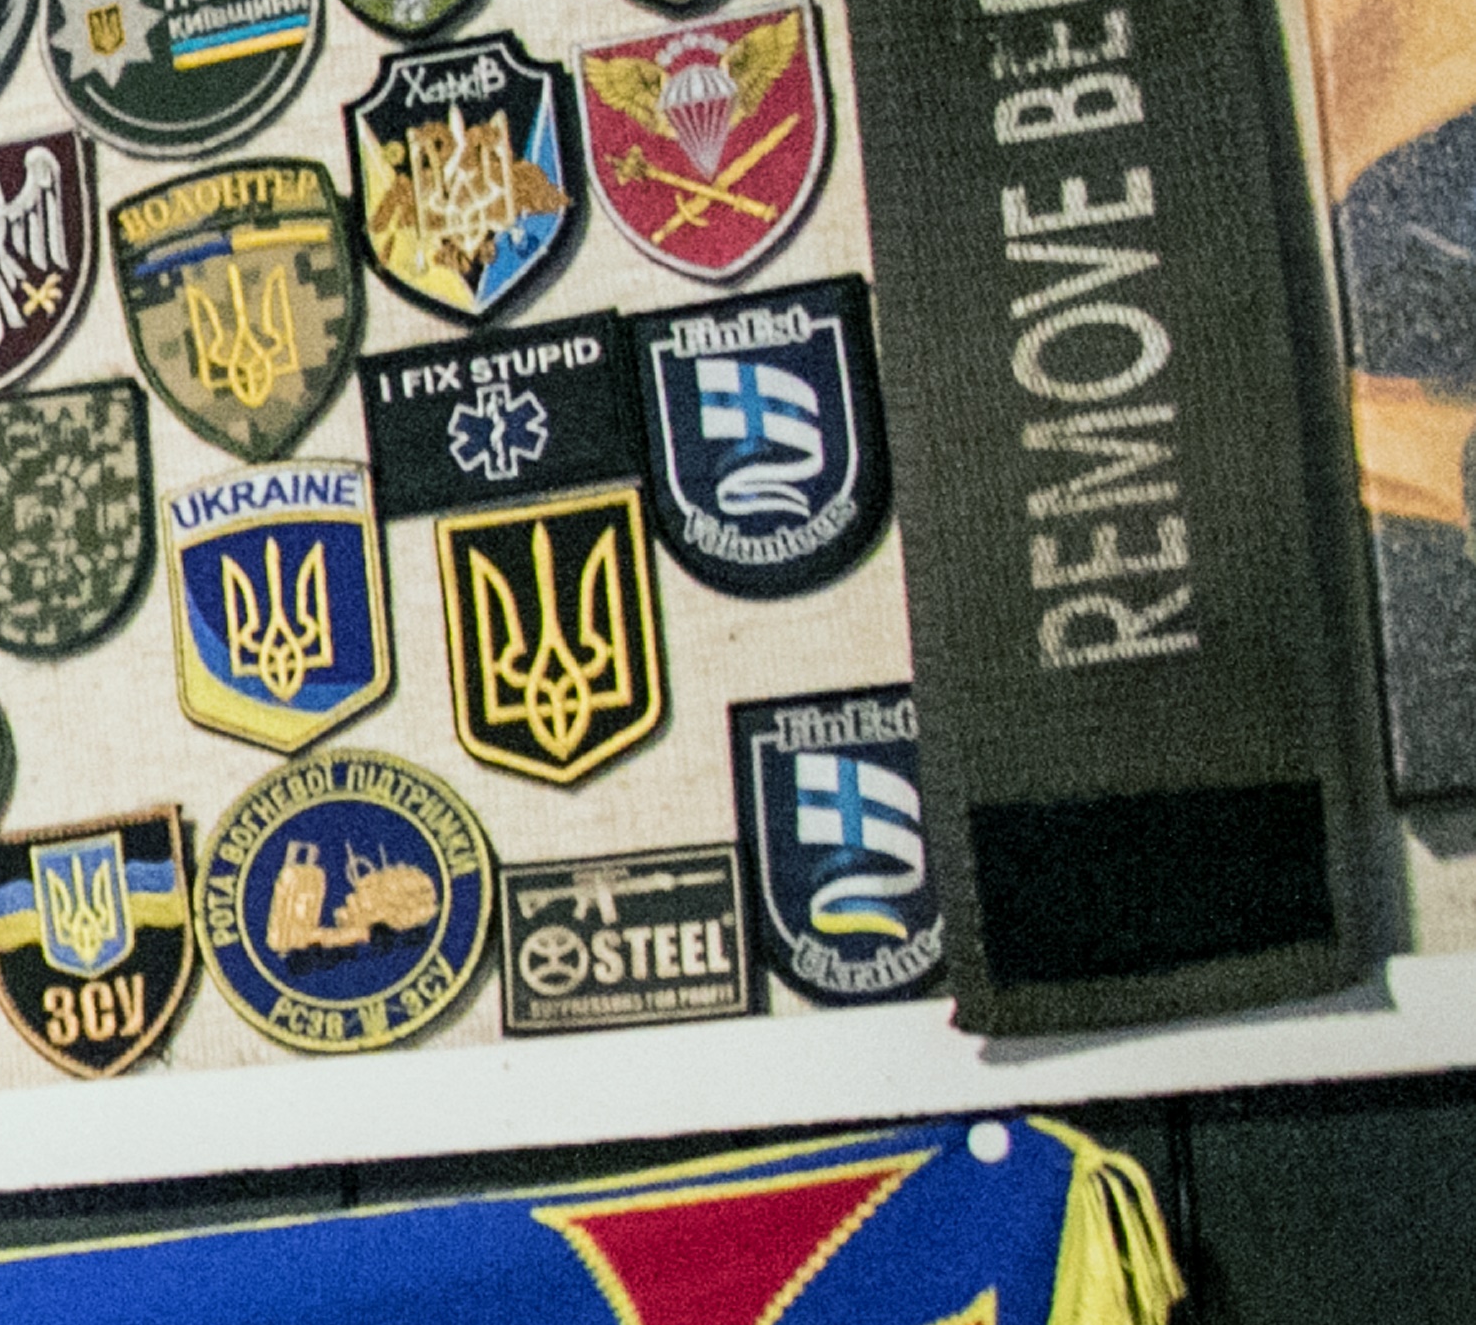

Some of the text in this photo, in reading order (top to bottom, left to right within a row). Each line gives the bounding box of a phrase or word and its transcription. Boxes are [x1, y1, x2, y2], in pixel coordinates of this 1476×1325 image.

[119, 169, 320, 244] ВОЛОНТЕР
[378, 335, 603, 405] I FIX STUPID
[997, 164, 1201, 674] REMOVE
[172, 473, 360, 531] UKRAINE
[209, 762, 481, 948] РОТА ВОГНЕВОЇ ПІДТРИМКИ
[591, 917, 731, 984] STEEL
[42, 973, 147, 1046] ЗСУ
